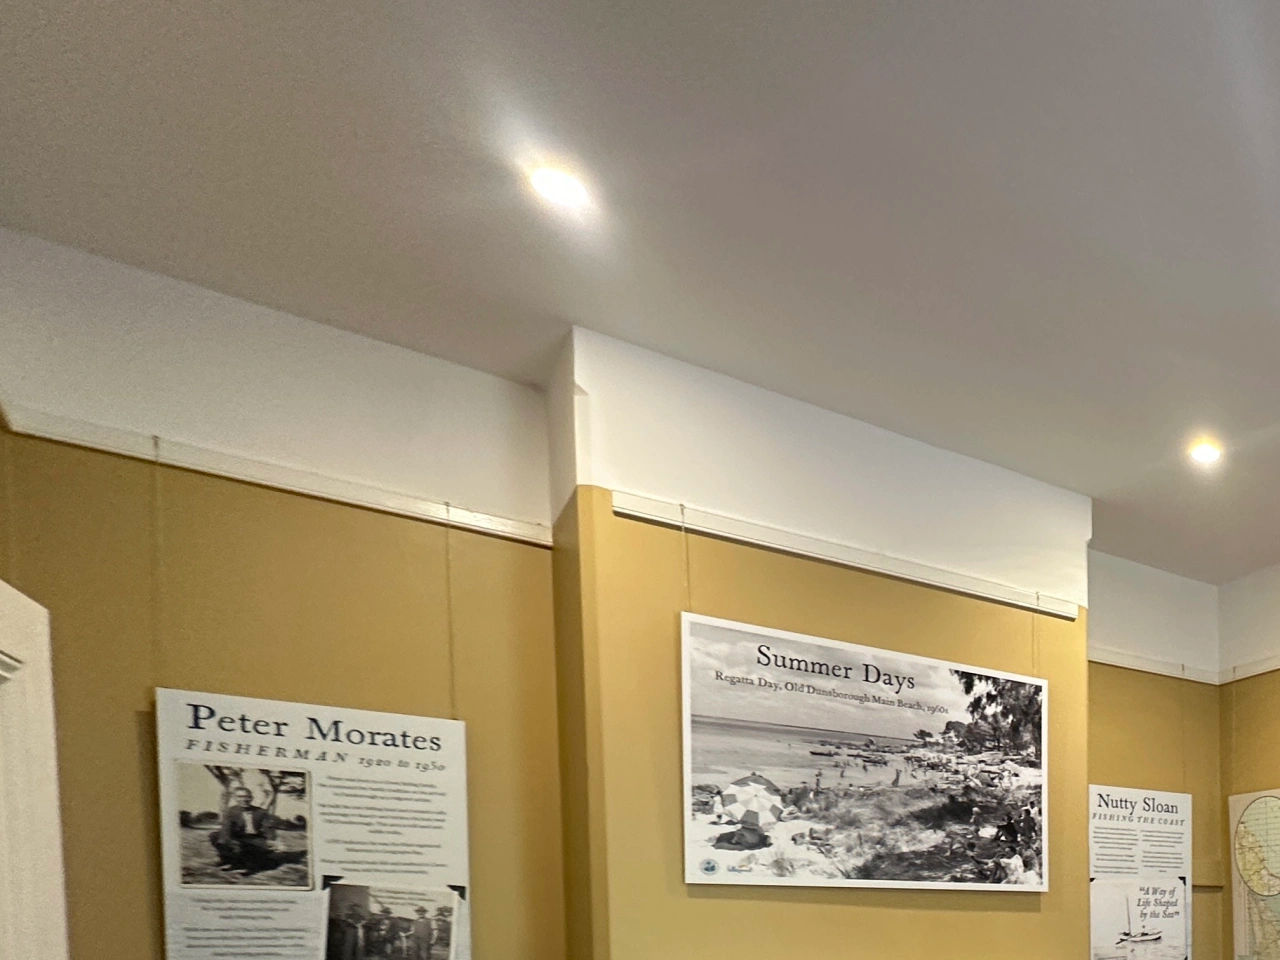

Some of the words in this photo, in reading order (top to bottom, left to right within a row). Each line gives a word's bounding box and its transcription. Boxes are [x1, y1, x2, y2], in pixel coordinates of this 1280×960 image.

[757, 644, 853, 679] Summer
[862, 663, 915, 694] Days
[715, 670, 754, 686] Regatta
[784, 681, 804, 694] Old
[806, 685, 871, 704] Dunsborough
[872, 695, 895, 706] Main
[897, 699, 925, 712] Beach,
[186, 703, 288, 737] Peter
[306, 717, 442, 751] Morates
[184, 739, 350, 763] FISHERMAN
[397, 759, 410, 768] to
[1097, 793, 1137, 815] Nutty
[1143, 797, 1178, 814] Sloan
[1092, 812, 1134, 823] FISHING
[1137, 816, 1155, 824] THE
[1158, 818, 1185, 826] COAST
[1137, 898, 1151, 909] Life
[1153, 898, 1178, 909] Shaped
[1140, 910, 1147, 921] by
